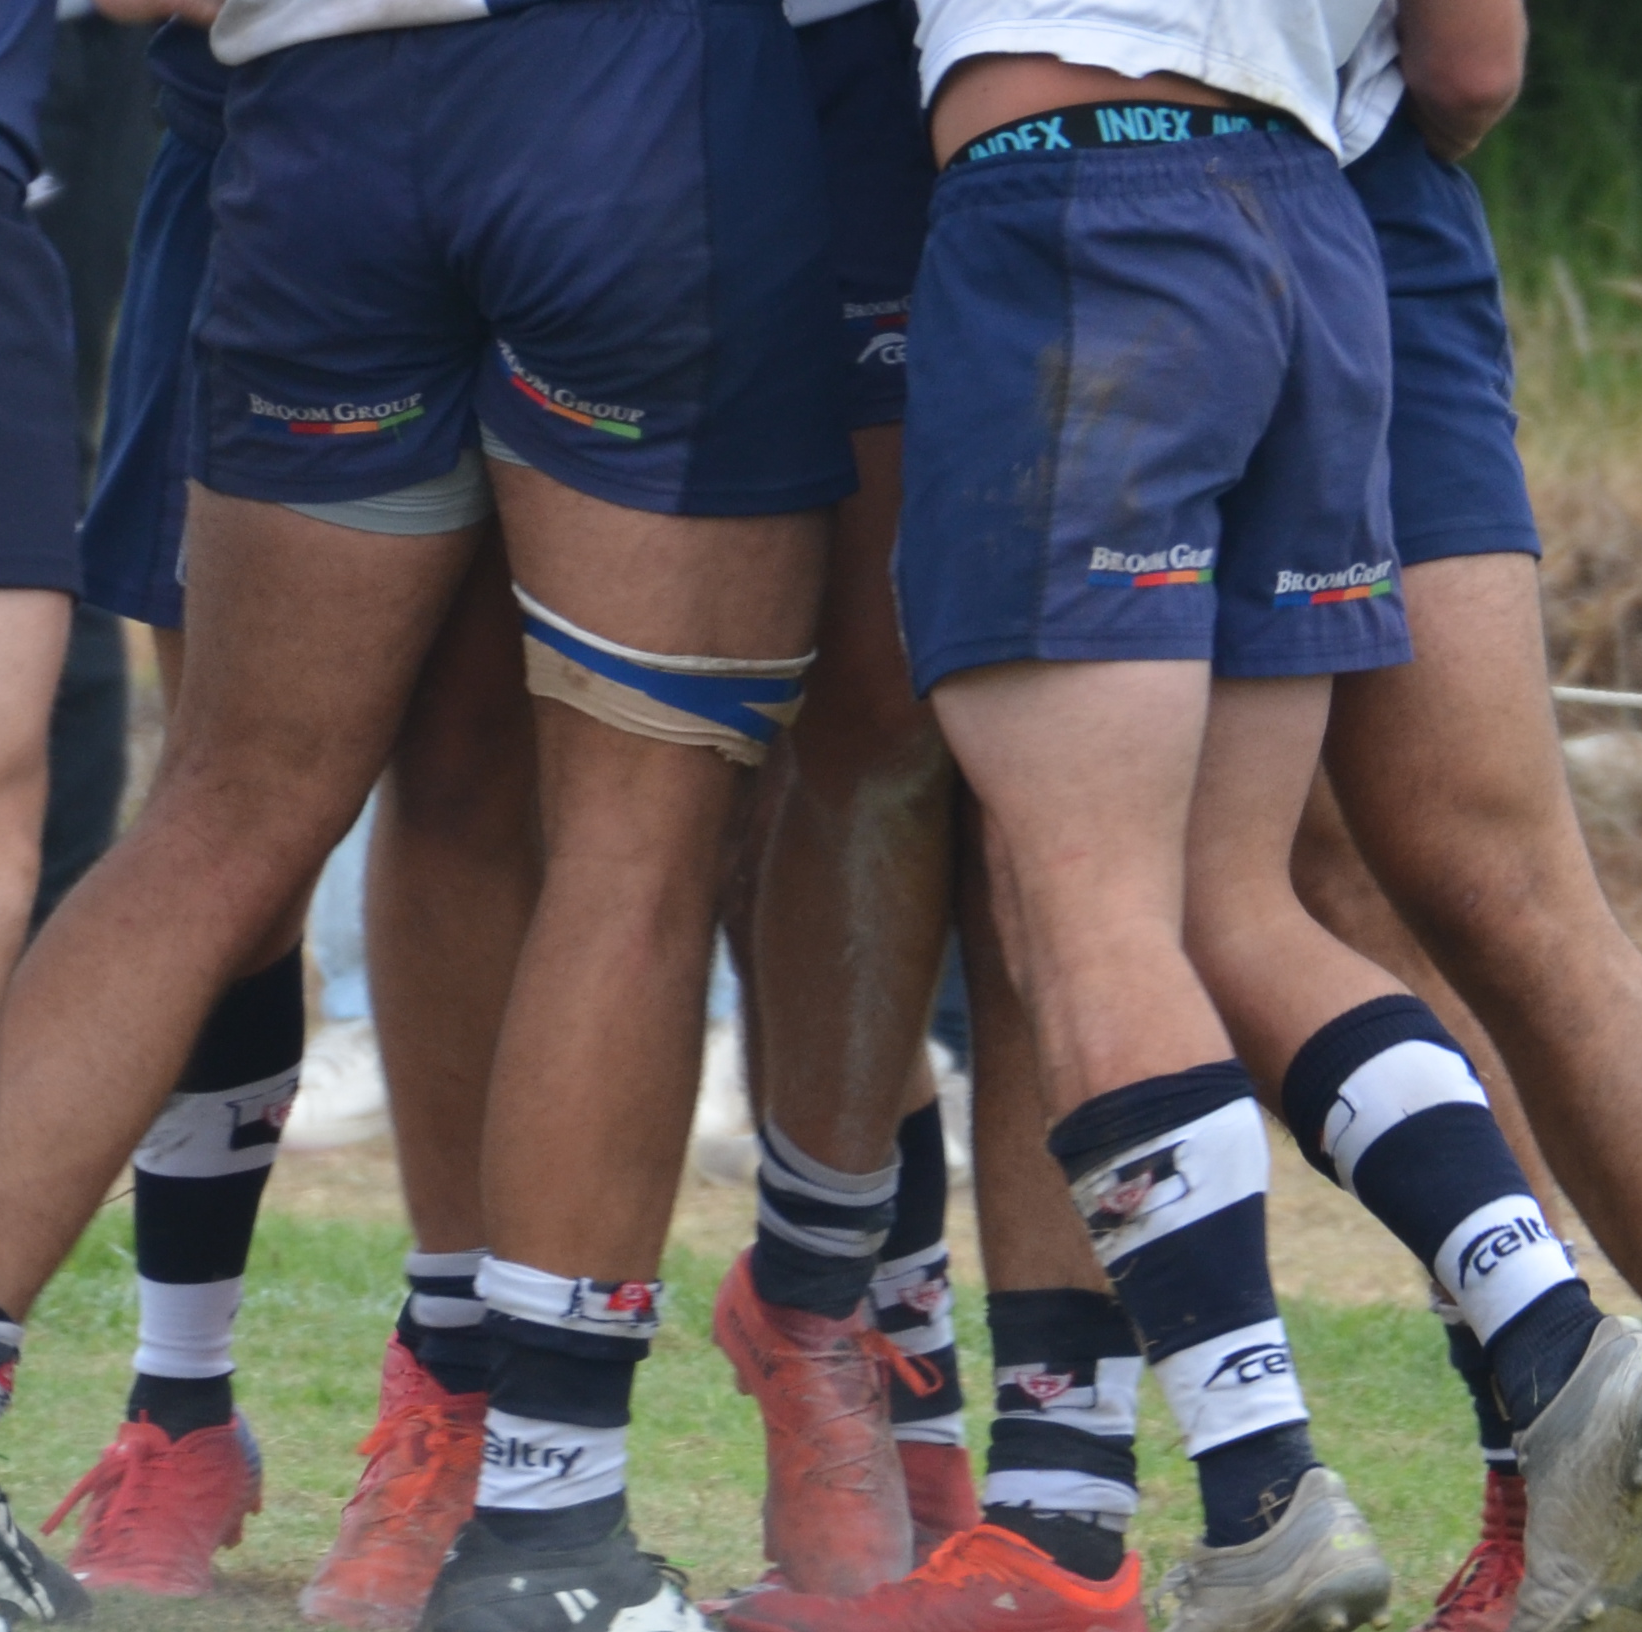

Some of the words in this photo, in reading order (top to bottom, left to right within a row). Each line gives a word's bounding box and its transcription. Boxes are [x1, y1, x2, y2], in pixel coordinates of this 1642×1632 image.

[1094, 106, 1193, 144] INDEX
[248, 393, 332, 421] BROOM
[333, 392, 423, 422] GROUP
